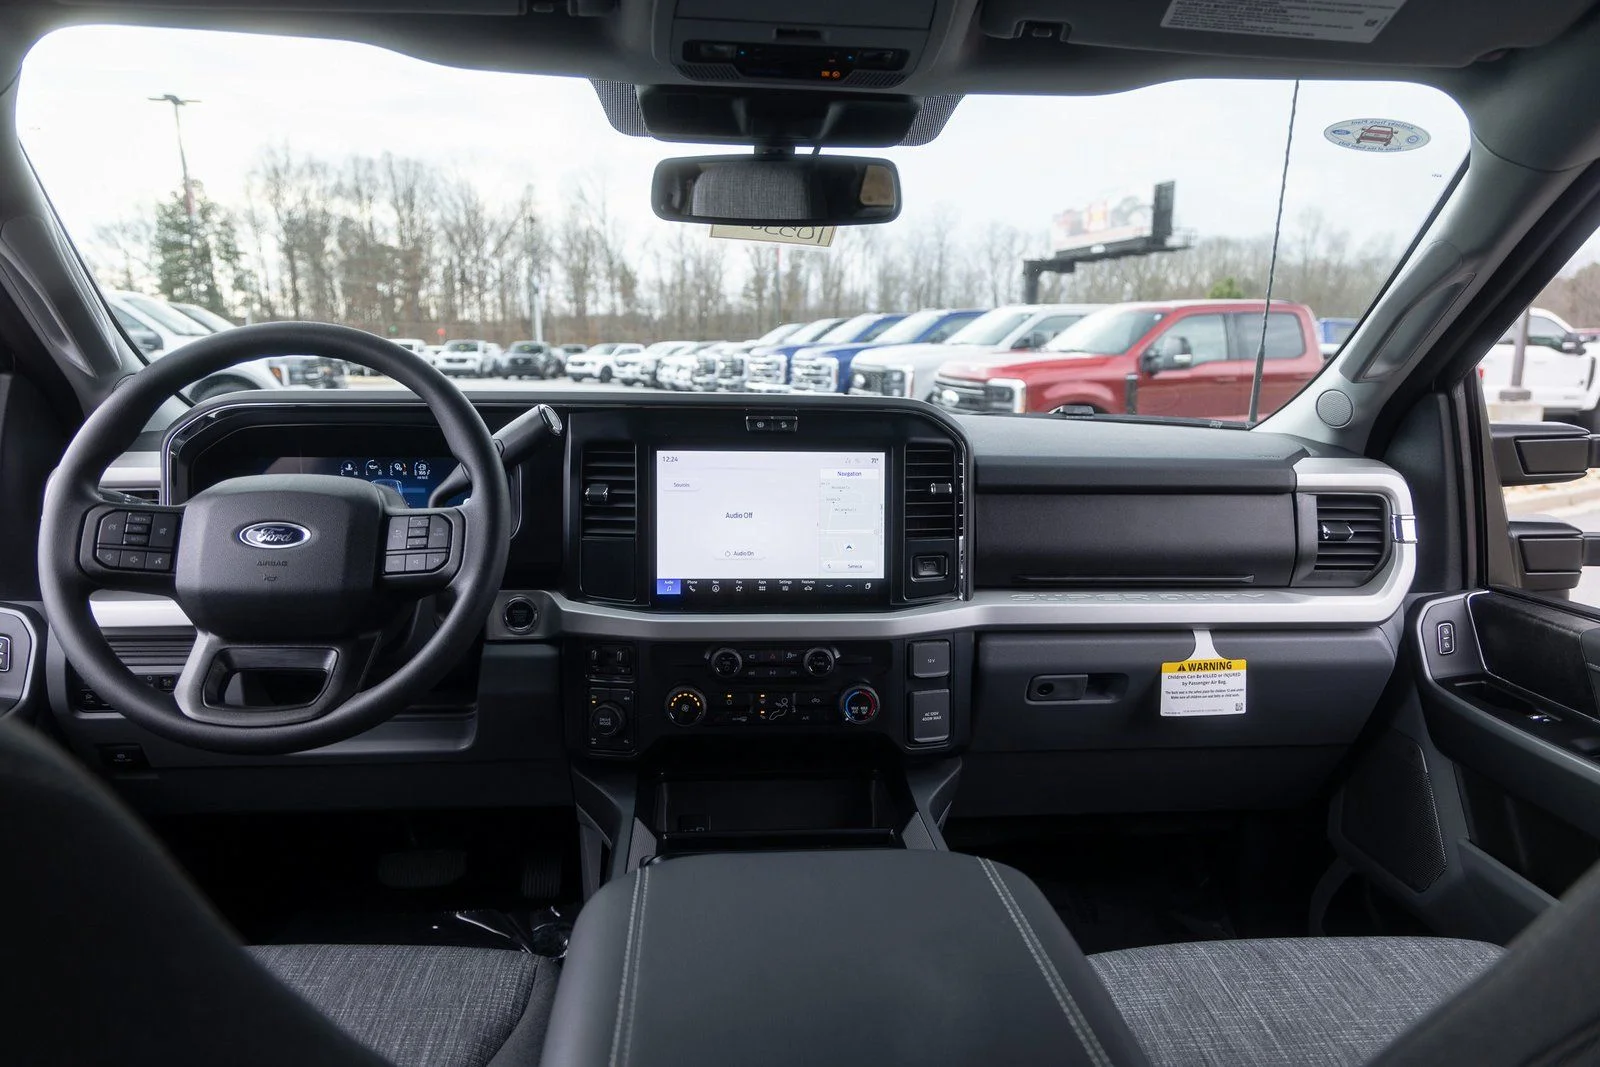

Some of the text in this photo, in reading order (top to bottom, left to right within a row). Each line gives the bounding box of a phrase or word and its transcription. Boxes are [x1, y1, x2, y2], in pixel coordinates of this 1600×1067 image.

[256, 528, 292, 542] Ford
[1010, 593, 1150, 601] SUPER
[1188, 661, 1232, 671] WARNING
